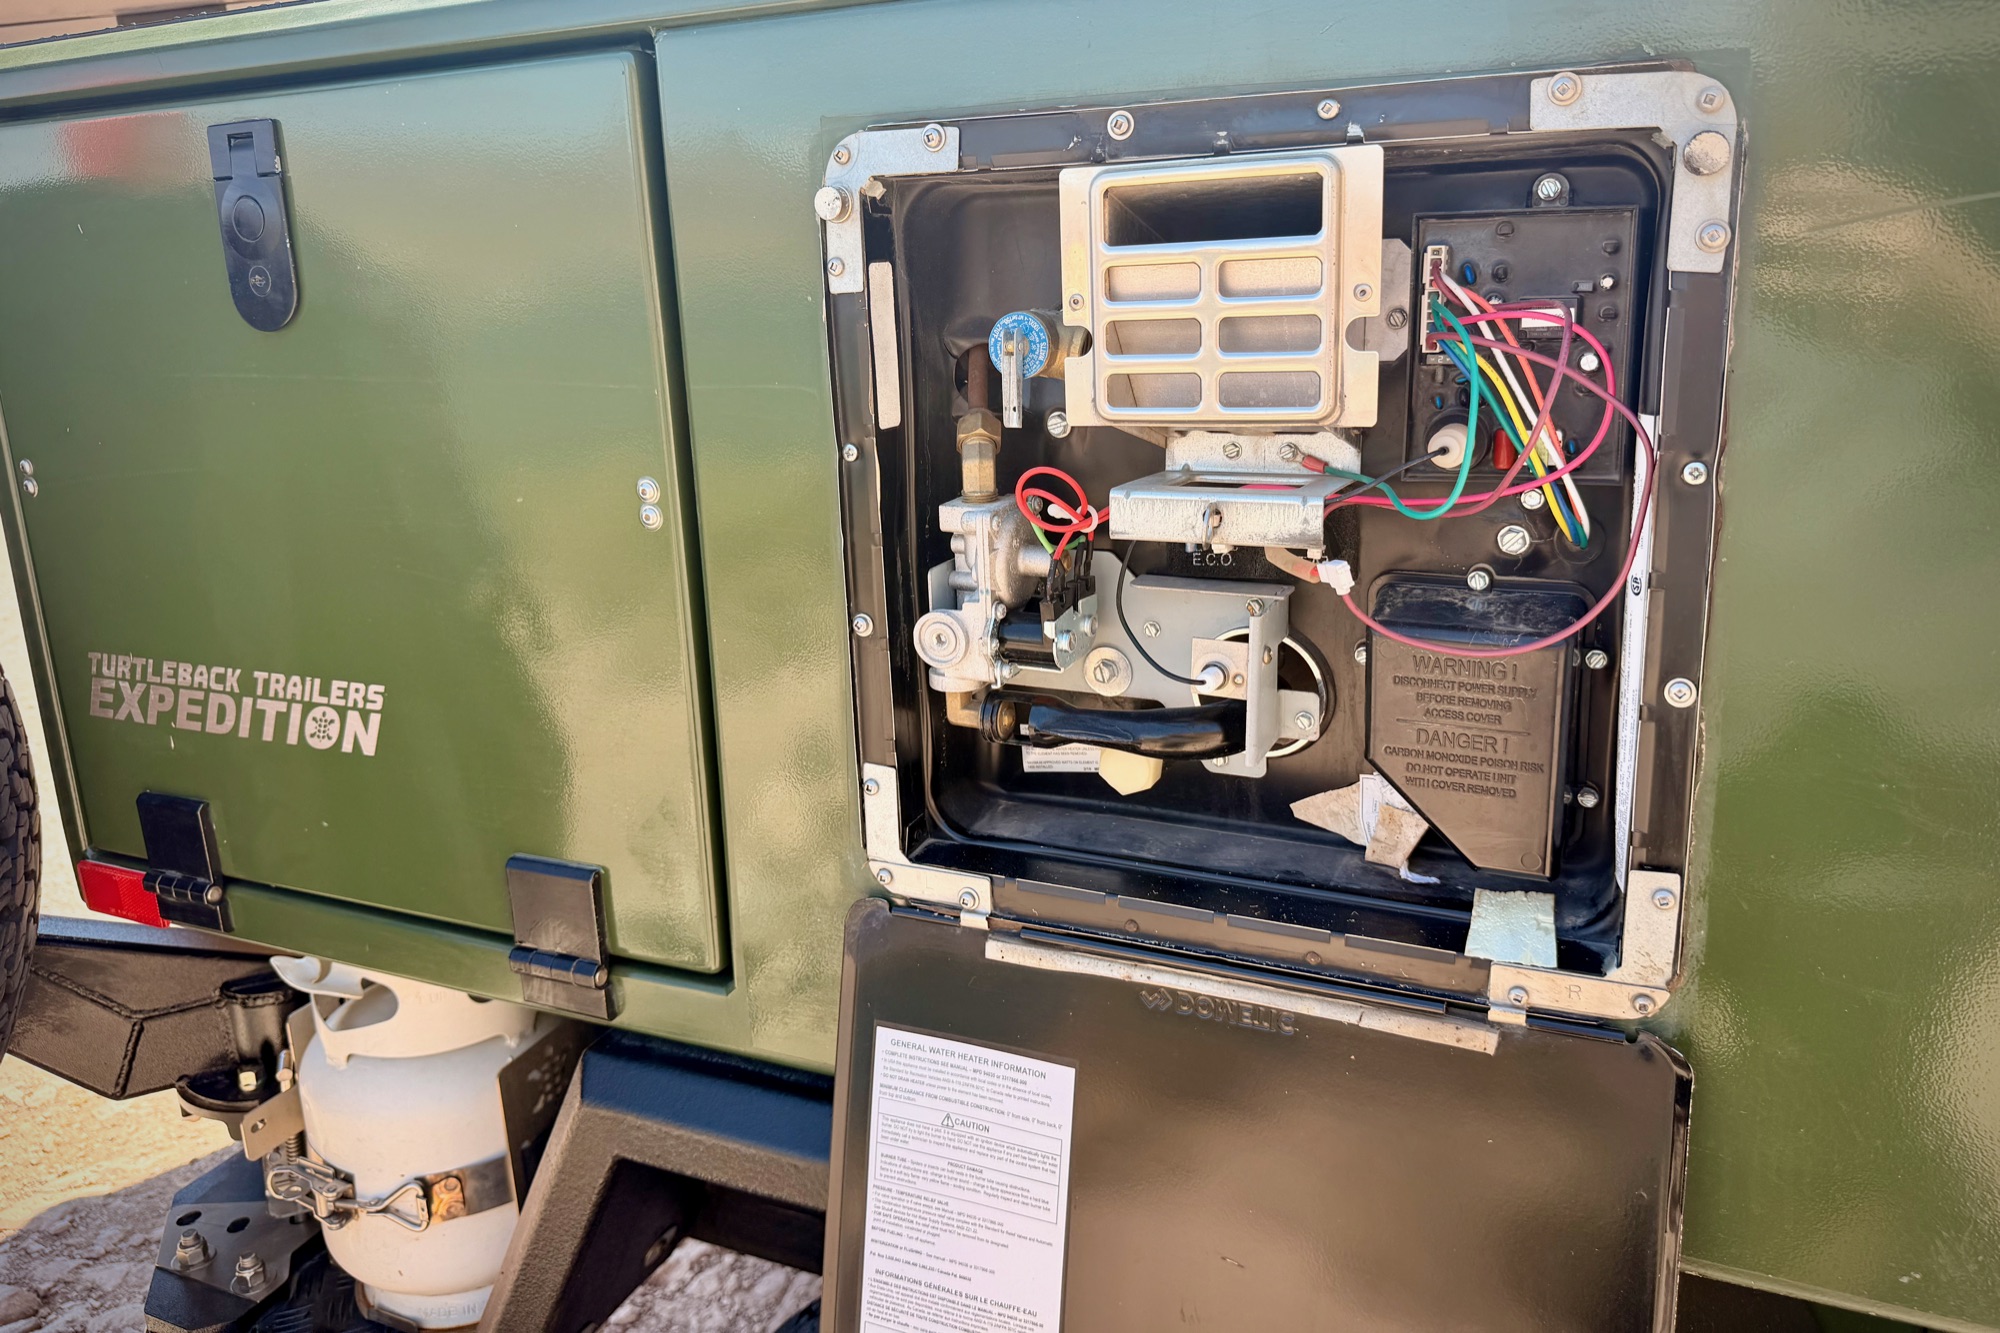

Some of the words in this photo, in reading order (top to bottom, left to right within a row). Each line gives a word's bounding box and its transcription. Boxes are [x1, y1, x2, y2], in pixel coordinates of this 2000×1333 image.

[1192, 552, 1236, 566] E.C.O.
[88, 652, 242, 693] TURTLEBACK
[253, 671, 386, 711] TRAILERS
[1393, 675, 1457, 691] DISCONNECT
[1458, 681, 1495, 694] POWER
[1497, 685, 1538, 699] SUPPLY
[1416, 692, 1456, 706] BEFORE
[1458, 695, 1512, 712] REMOVING
[89, 676, 382, 757] EXPEDITION
[1424, 708, 1464, 721] ACCESS
[1467, 712, 1502, 725] COVER
[1416, 728, 1497, 753] DANGER
[1384, 745, 1425, 759] CARBON
[1426, 749, 1478, 766] MONOXIDE
[1479, 756, 1518, 769] POISON
[1520, 759, 1544, 773] RISK
[1406, 762, 1421, 773] DO
[1422, 764, 1443, 775] NOT
[1444, 766, 1491, 782] OPERATE
[1493, 771, 1516, 784] UNIT
[1405, 776, 1430, 788] WITH
[1431, 779, 1465, 792] COVER
[1466, 783, 1516, 799] REMOVED
[1568, 984, 1581, 1000] R
[885, 1048, 907, 1058] COMPLETE
[908, 1053, 939, 1066] INSTRUCTIONS
[940, 1060, 948, 1068] SEE
[950, 1063, 967, 1072] MANUAL
[890, 1037, 927, 1052] GENERAL
[928, 1045, 955, 1058] WATER
[957, 1052, 988, 1066] HEATER
[990, 1059, 1046, 1079] INFORMATION
[954, 1117, 989, 1133] CAUTION
[875, 1267, 922, 1286] INFORMATIONS
[964, 1292, 978, 1301] SUR
[979, 1296, 988, 1304] LE
